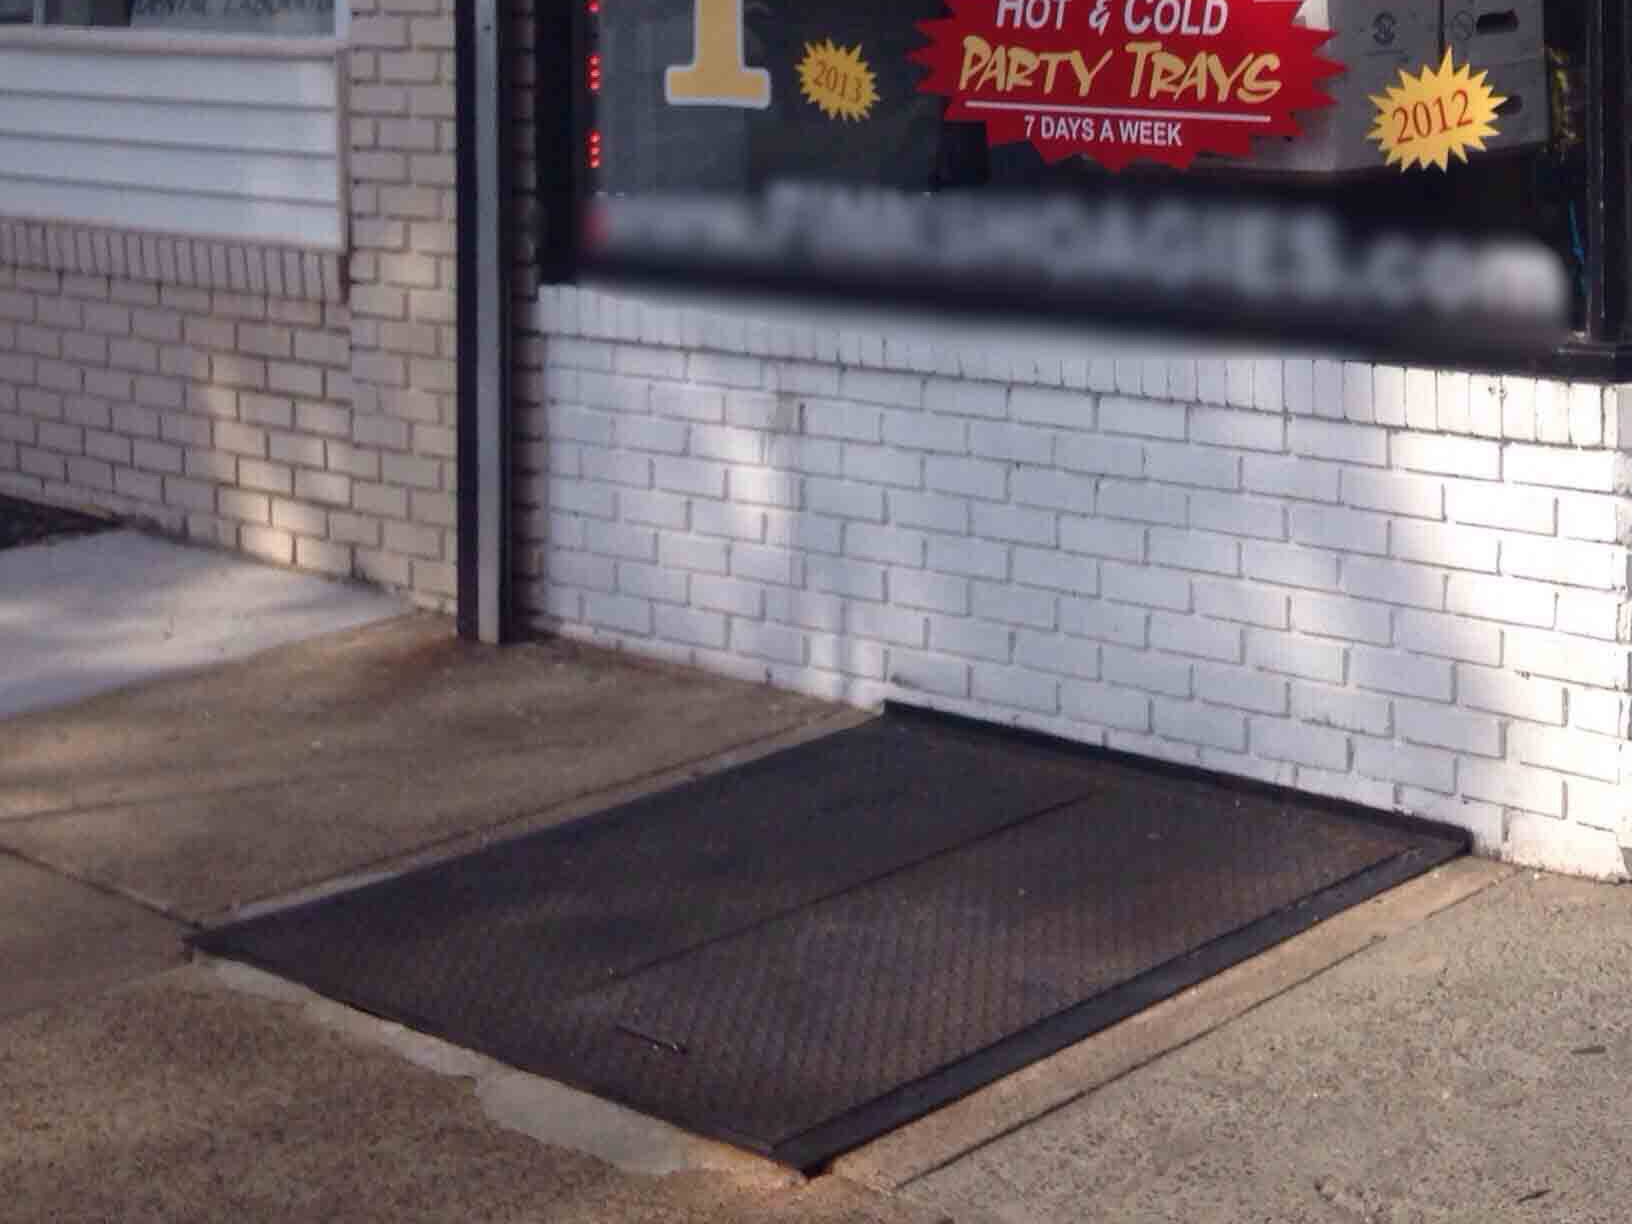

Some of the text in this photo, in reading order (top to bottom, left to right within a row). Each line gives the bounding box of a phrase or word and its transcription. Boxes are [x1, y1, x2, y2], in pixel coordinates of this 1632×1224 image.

[812, 58, 864, 104] 2013
[959, 35, 1283, 104] PARTY TRAYS
[1024, 115, 1183, 146] 7 DAYS A WEEK
[1392, 88, 1473, 145] 2012
